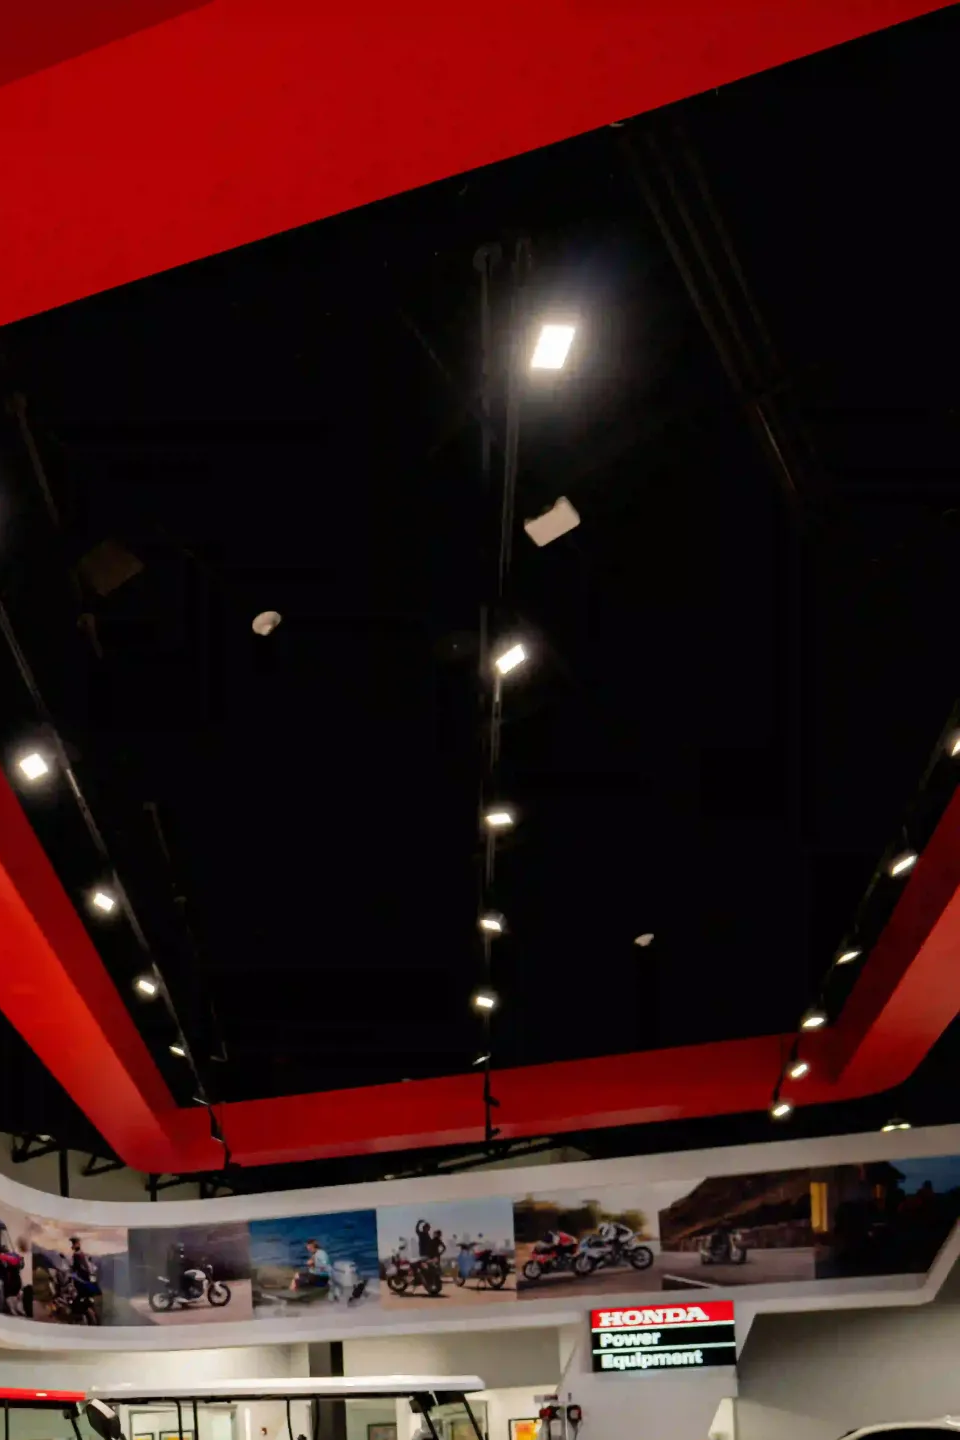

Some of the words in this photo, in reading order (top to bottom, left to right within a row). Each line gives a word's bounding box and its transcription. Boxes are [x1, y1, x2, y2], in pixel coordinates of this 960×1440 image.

[598, 1306, 710, 1327] HONDA
[600, 1332, 661, 1347] Power
[601, 1350, 703, 1370] Equipment
